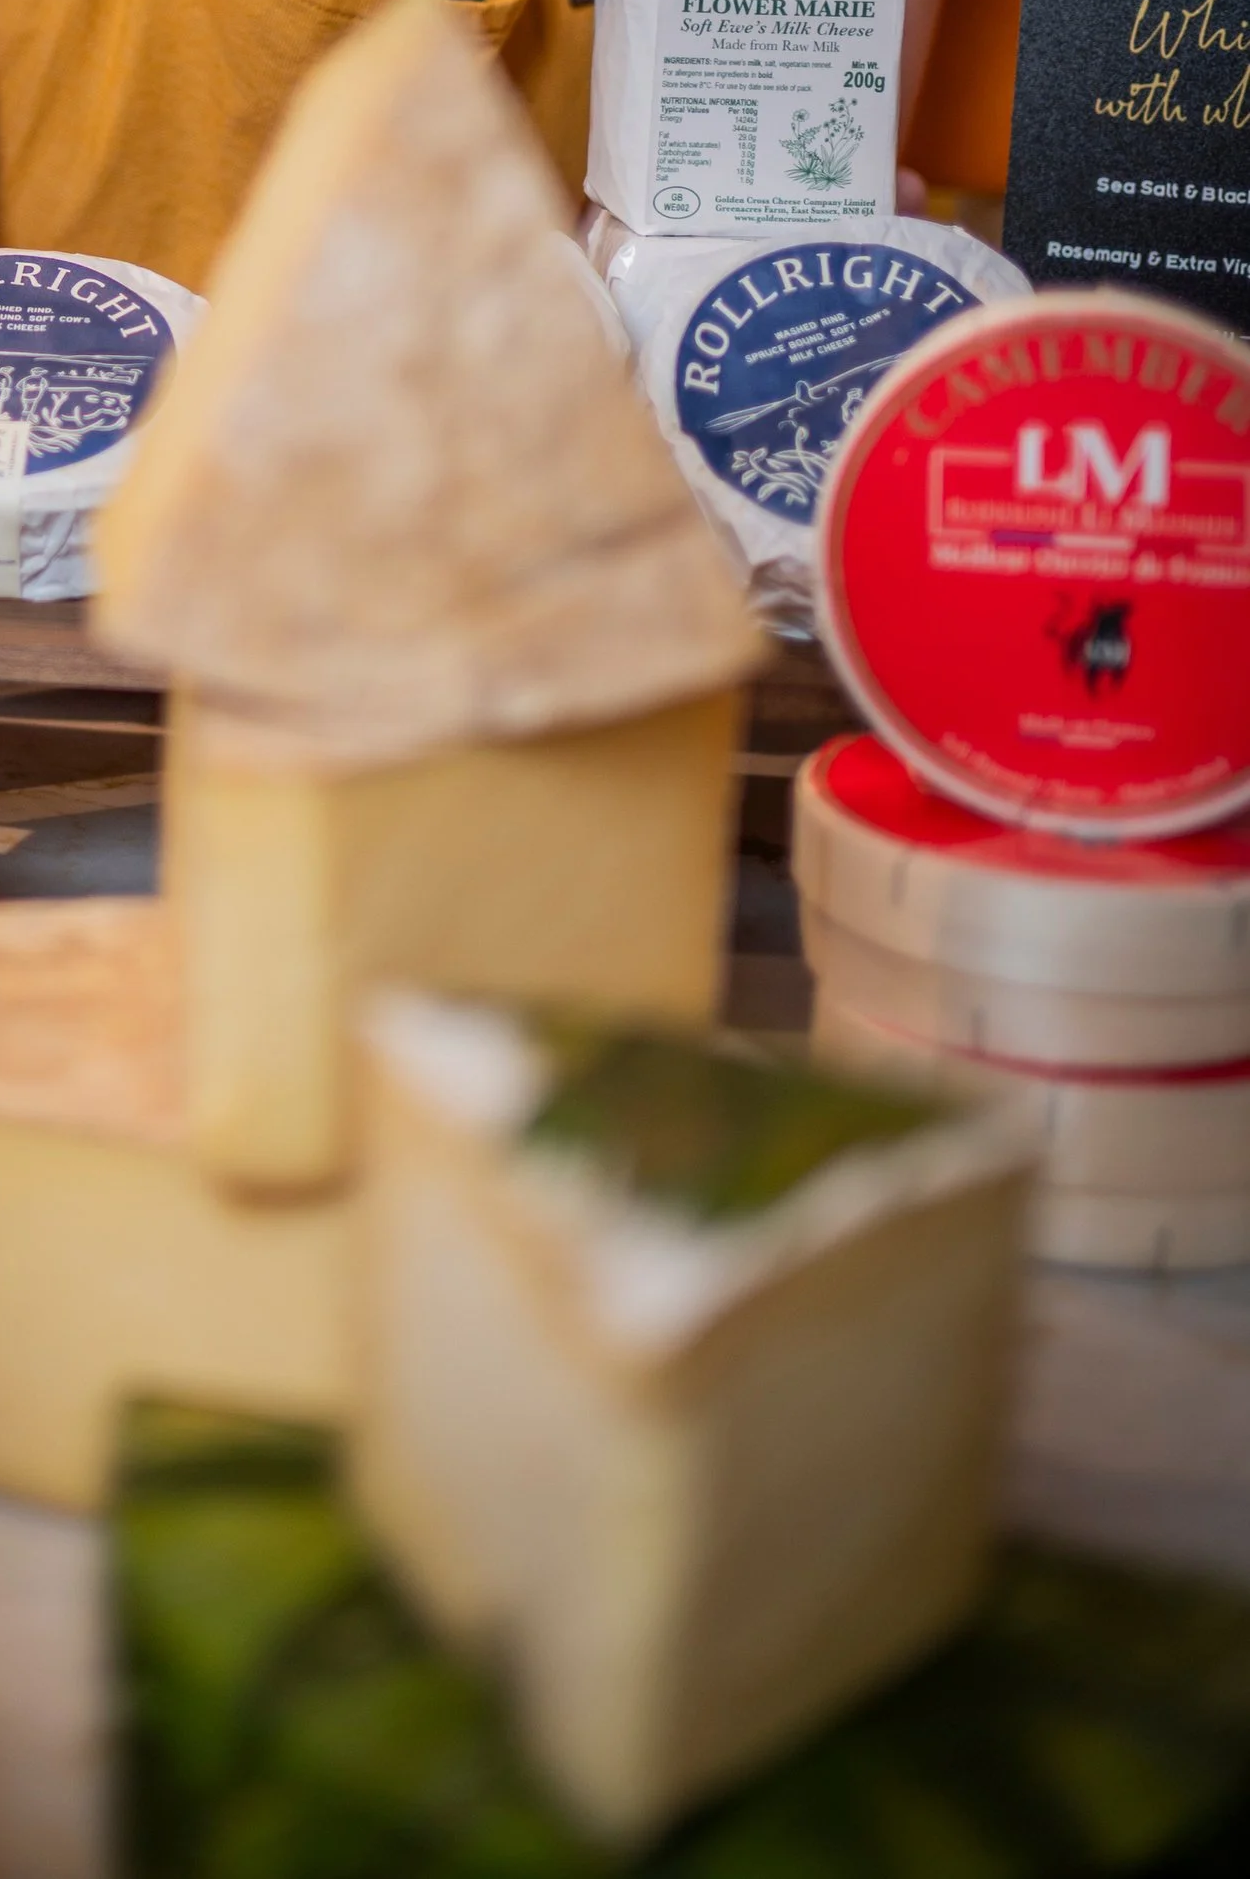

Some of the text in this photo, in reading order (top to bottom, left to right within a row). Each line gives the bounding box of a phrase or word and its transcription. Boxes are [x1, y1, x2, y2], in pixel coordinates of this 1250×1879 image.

[794, 0, 876, 18] MARIE
[681, 18, 874, 38] Soft Ewe's Milk Cheese
[712, 38, 841, 53] Made from Raw Milk
[663, 56, 712, 66] INGREDIENTS:
[713, 58, 728, 66] Raw
[779, 61, 811, 70] vegetarian
[852, 60, 879, 71] Min Wt.
[675, 69, 703, 79] allergens
[716, 70, 750, 80] ingredients
[679, 81, 698, 89] below
[715, 81, 726, 90] For
[739, 83, 747, 92] by
[843, 71, 886, 93] 200g
[661, 96, 759, 107] NUTRITIONAL INFORMATION:
[1095, 68, 1187, 124] with
[661, 105, 686, 115] Typical
[687, 106, 710, 114] Values
[742, 108, 758, 117] 100g
[659, 113, 683, 123] Energy
[658, 130, 670, 139] Fat
[657, 148, 702, 158] Carbohydrate
[667, 157, 686, 165] which
[656, 164, 680, 173] Protein
[655, 173, 669, 182] Salt
[1096, 176, 1250, 205] Sea Salt & Blac
[663, 193, 690, 213] GB WE002
[715, 195, 877, 208] Golden Cross Cheese Company Limited
[715, 204, 763, 214] Greenacres
[764, 205, 789, 215] Farm,
[791, 206, 809, 215] East
[810, 207, 840, 216] Sussex,
[1046, 240, 1142, 270] Rosemary
[1147, 251, 1162, 266] &
[1165, 253, 1218, 273] Extra
[26, 306, 54, 315] RIND.
[28, 315, 55, 323] SOFT
[58, 315, 92, 324] COW'S
[684, 251, 964, 397] ROLLRIGHT
[6, 323, 48, 332] CHEESE
[773, 312, 849, 342] WASHED RIND.
[743, 308, 891, 364] SPRUCE BOUND. SOFT COW'S
[788, 334, 858, 363] MILK CHEESE
[1014, 420, 1170, 508] LM
